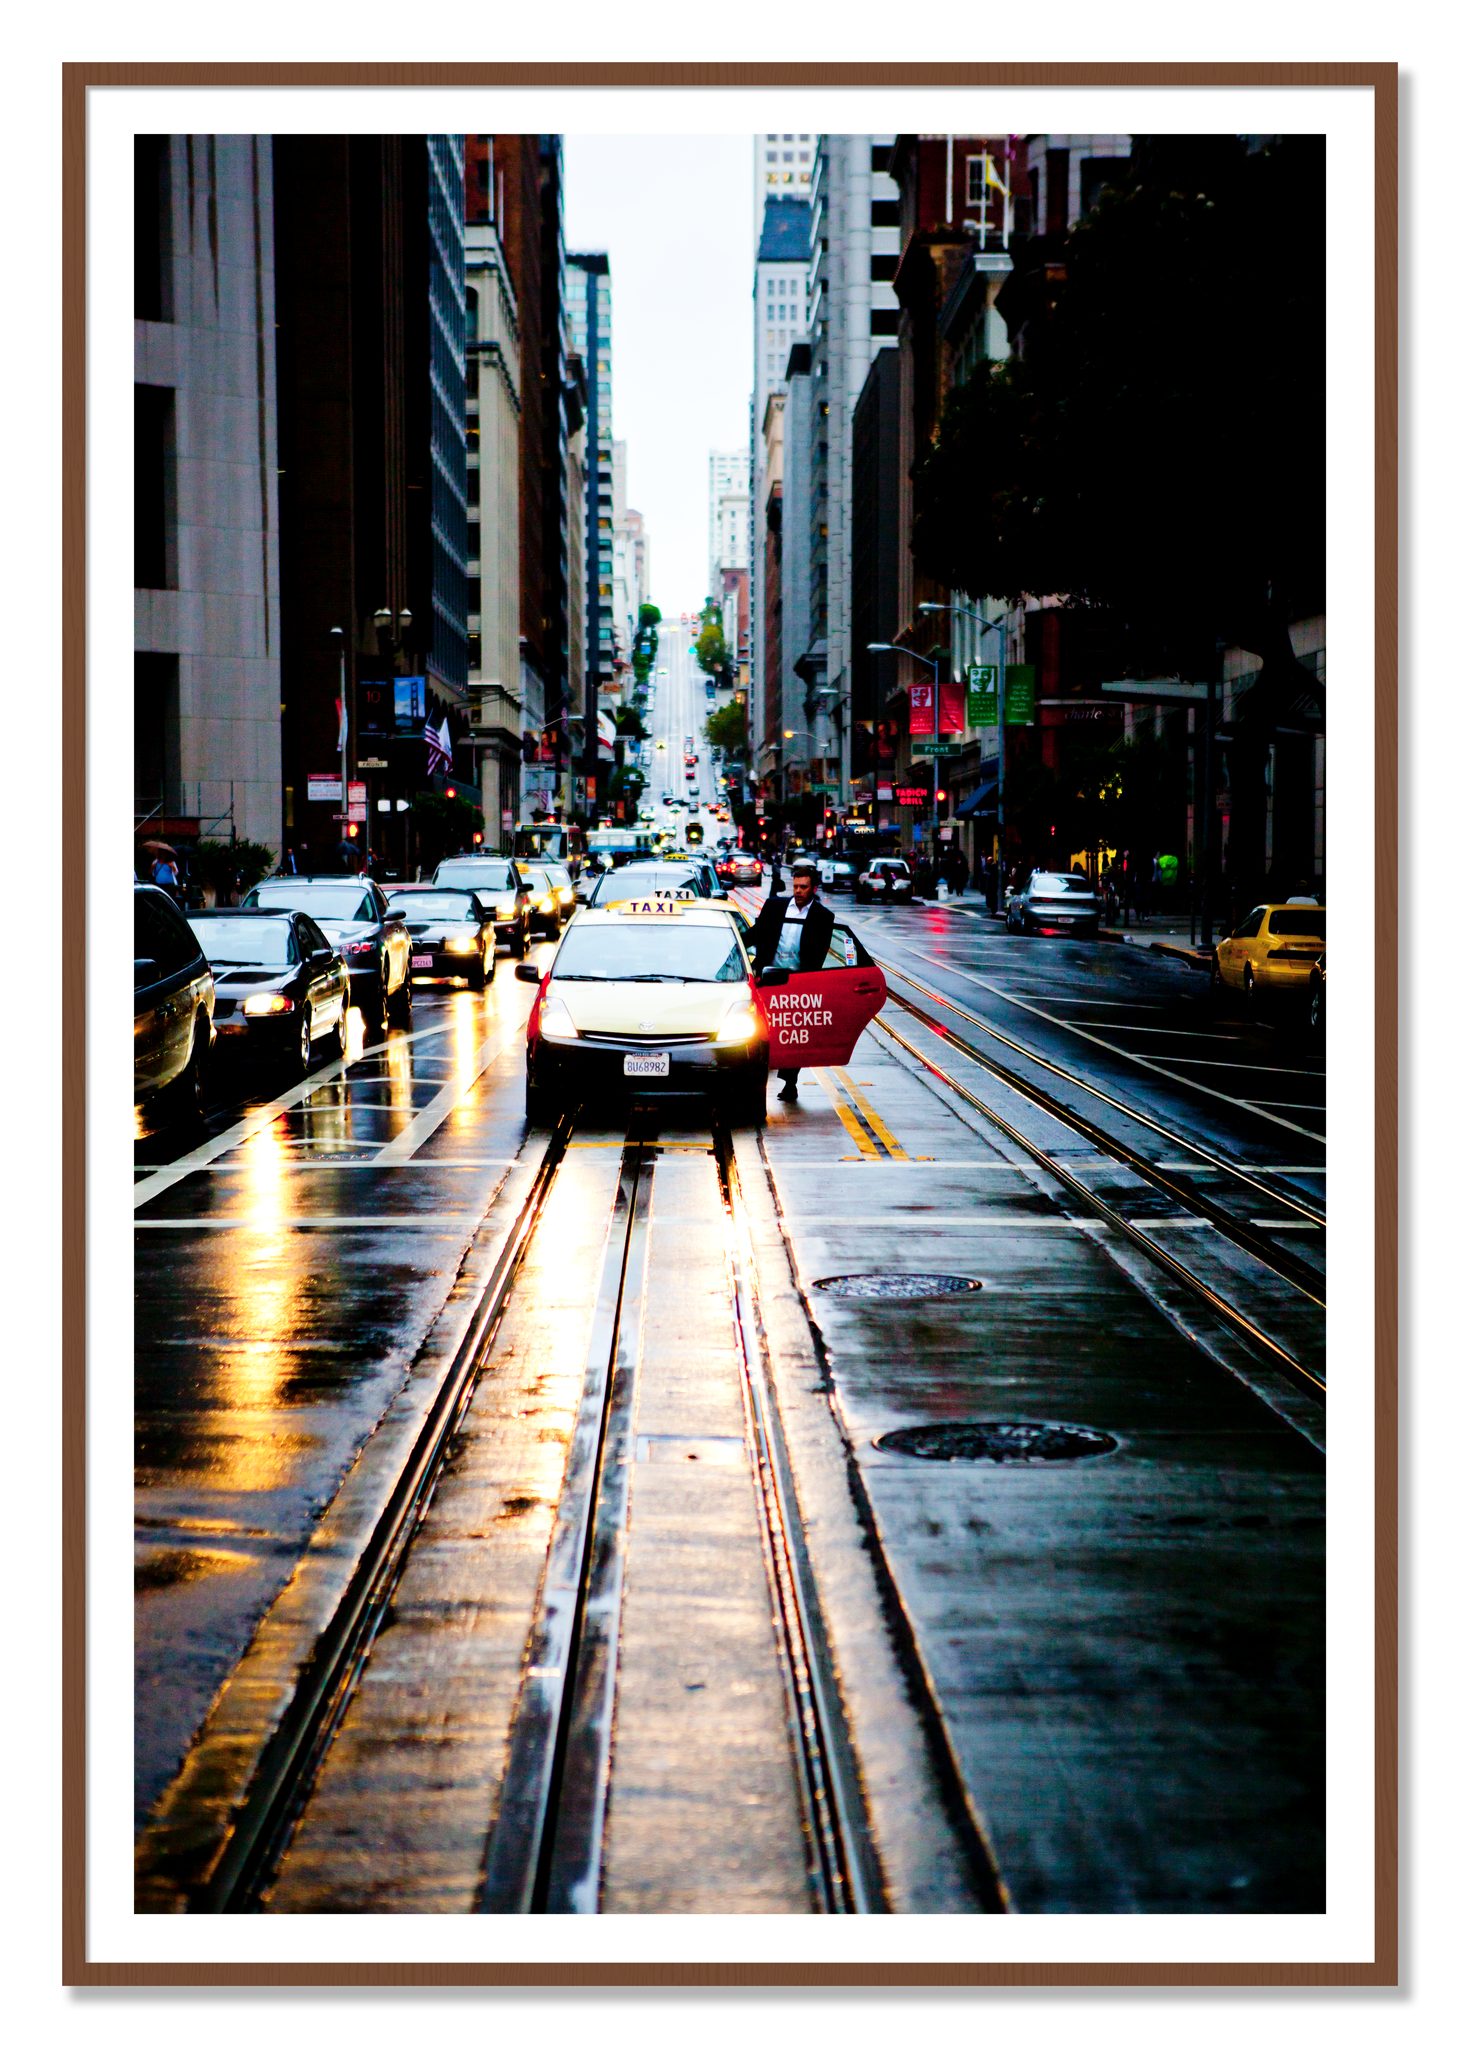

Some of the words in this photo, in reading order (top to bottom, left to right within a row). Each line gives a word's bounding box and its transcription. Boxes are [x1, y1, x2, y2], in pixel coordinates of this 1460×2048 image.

[896, 788, 927, 797] TADICH
[899, 797, 923, 805] GRILL
[655, 890, 690, 899] TAXI
[630, 902, 674, 913] TAXI
[769, 993, 823, 1009] ARROW
[778, 1029, 810, 1045] CAB
